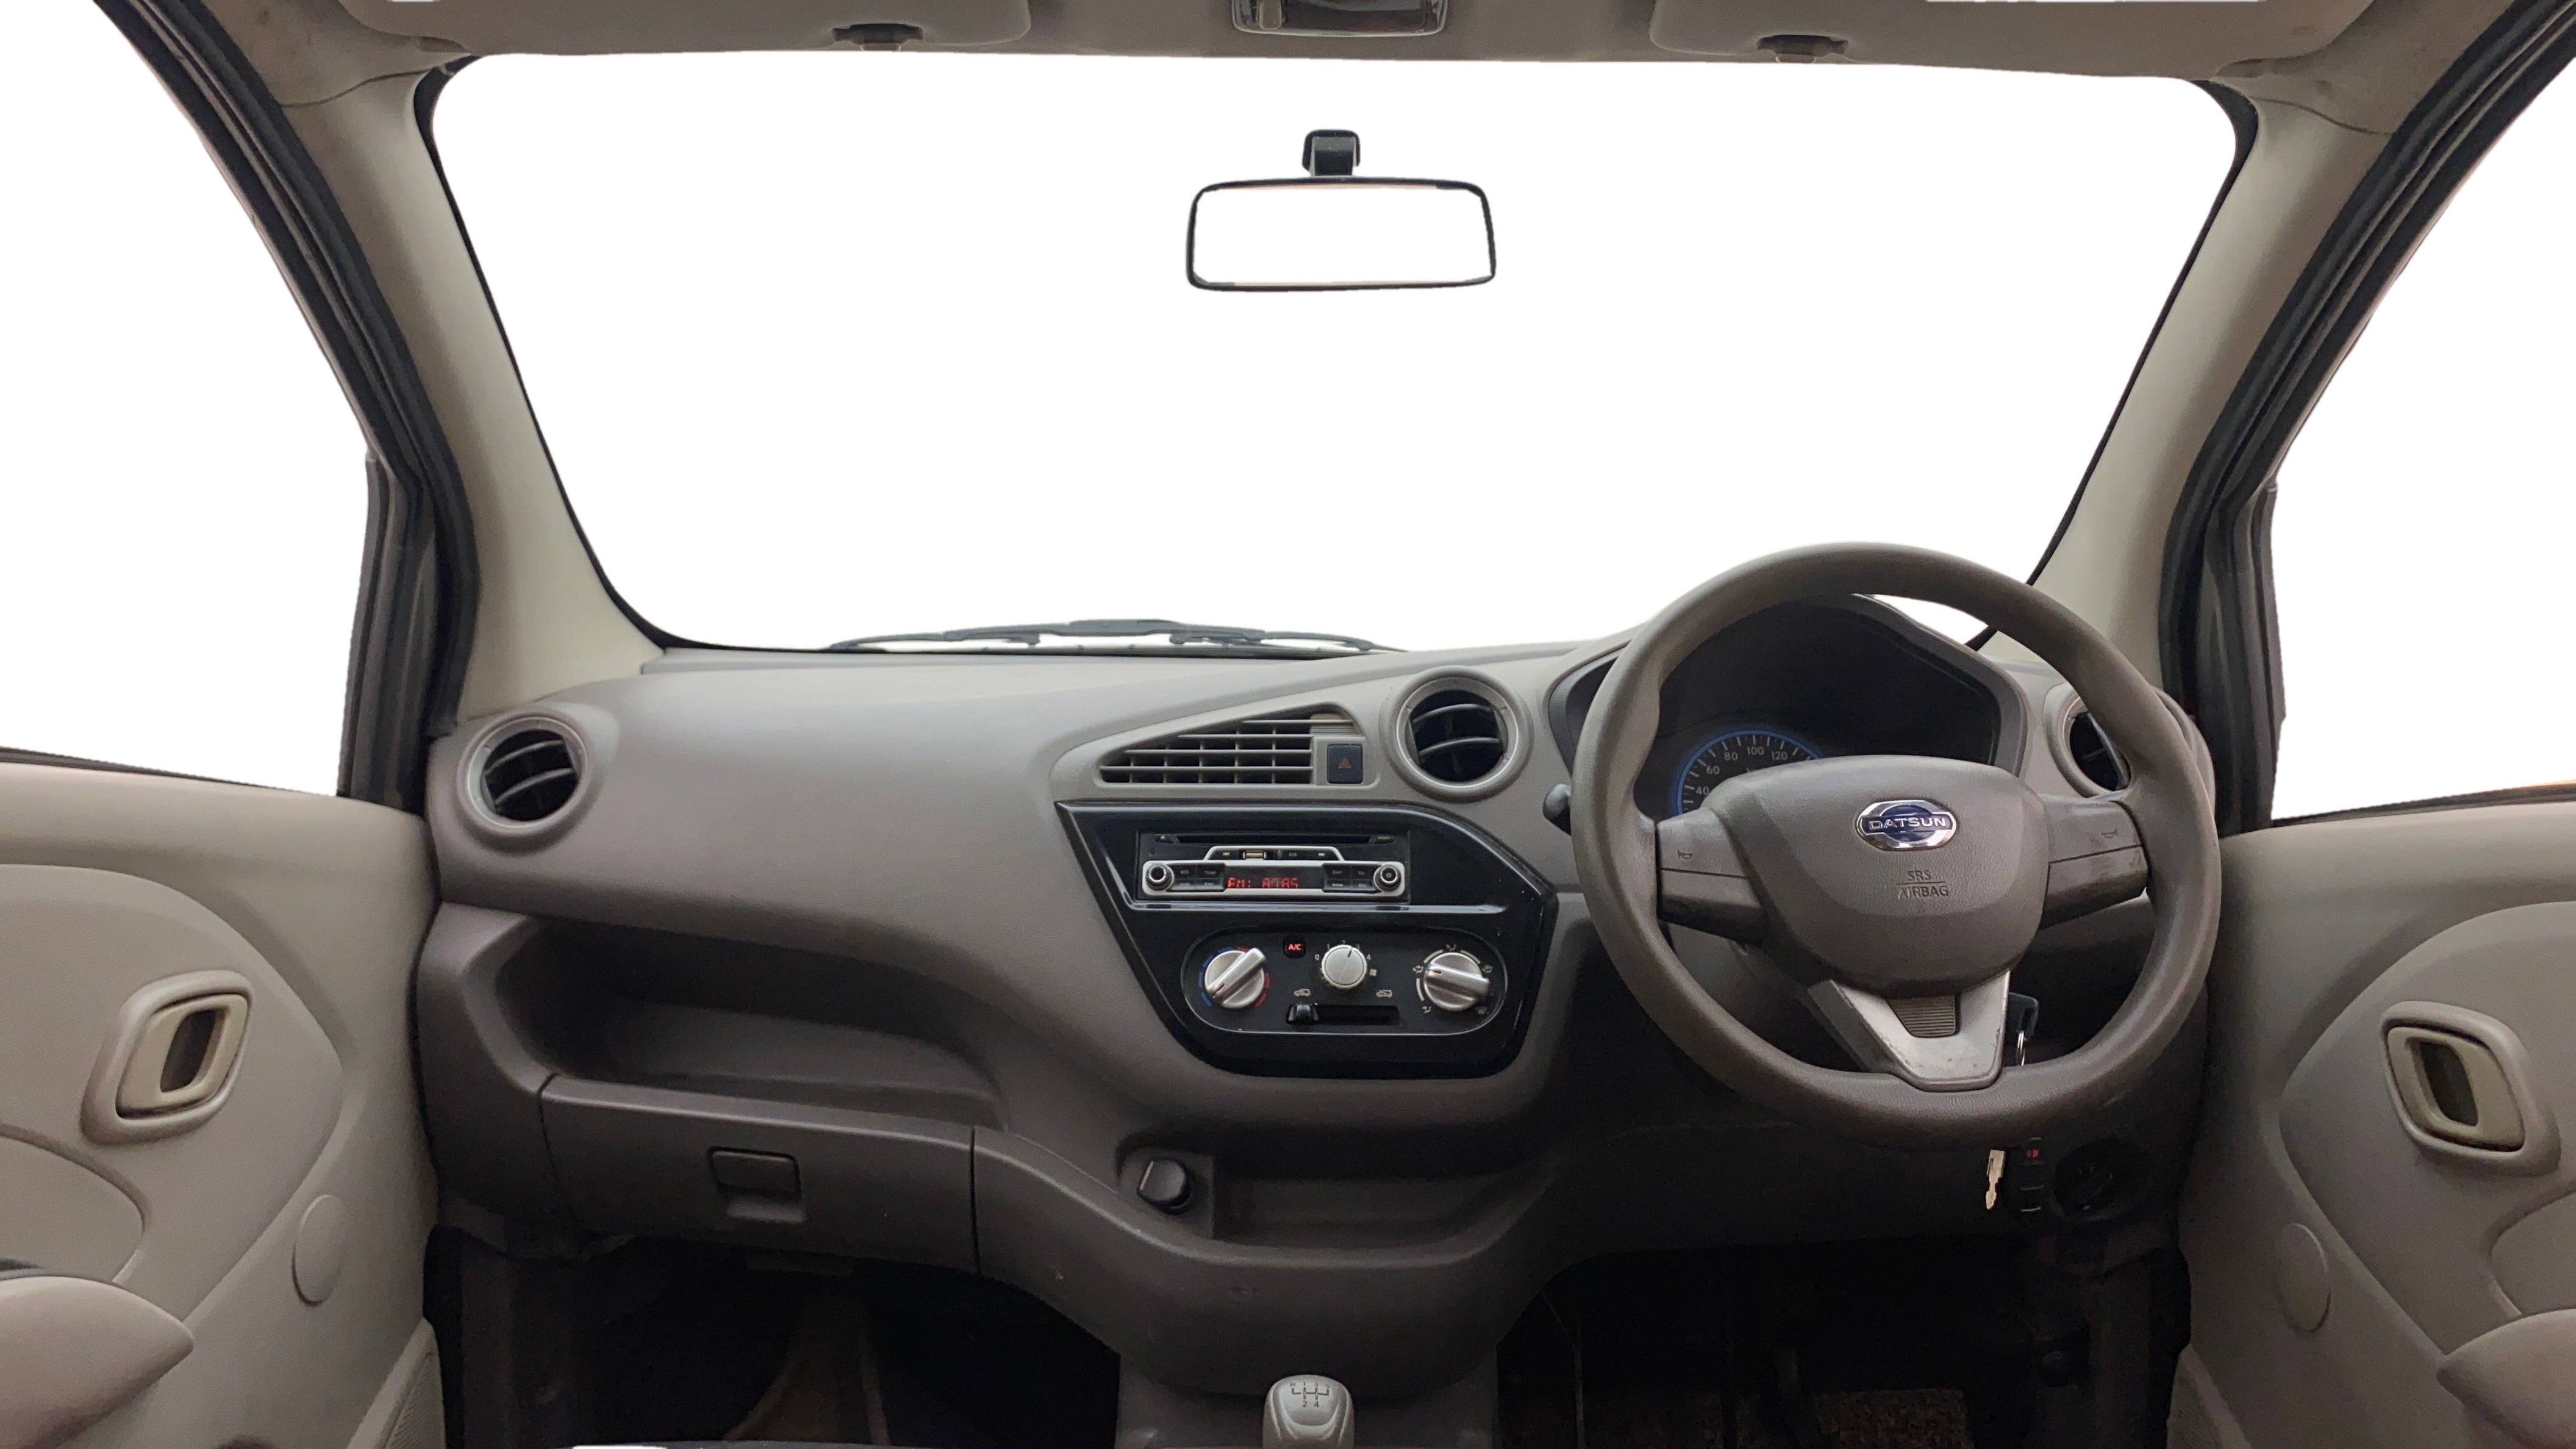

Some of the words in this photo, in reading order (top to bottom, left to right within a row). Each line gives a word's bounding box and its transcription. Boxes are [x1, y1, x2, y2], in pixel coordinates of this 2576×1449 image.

[1696, 785, 1709, 795] 40
[1706, 765, 1720, 775] 60
[1724, 751, 1737, 761] 80
[1747, 746, 1764, 756] 100
[1771, 751, 1788, 760] 120
[1869, 817, 1947, 831] DATSUN
[1907, 870, 1932, 881] SRS
[1897, 885, 1949, 900] AIRBAG
